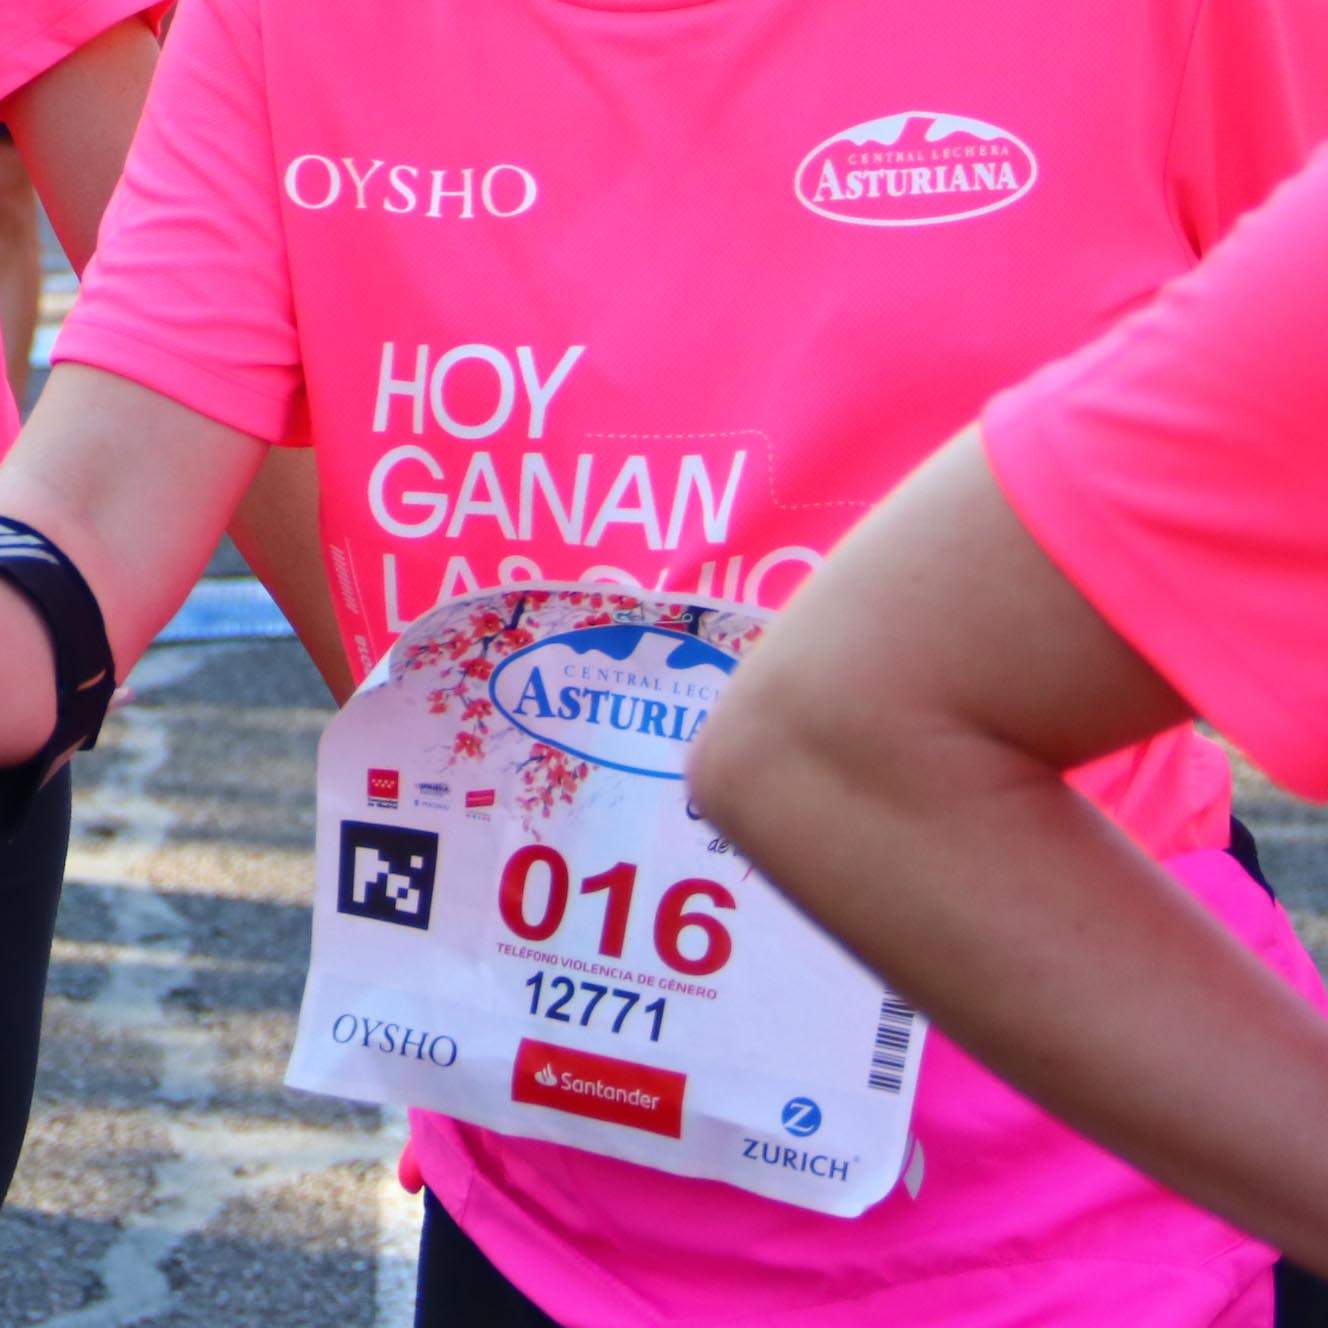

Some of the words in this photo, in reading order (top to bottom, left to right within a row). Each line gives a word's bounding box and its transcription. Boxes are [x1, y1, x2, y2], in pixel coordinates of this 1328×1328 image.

[812, 158, 1019, 203] ASTURIANA
[848, 151, 925, 165] CENTRAL
[930, 144, 1010, 160] LECHERA
[284, 154, 538, 219] OYSHO
[371, 341, 585, 441] HOY
[367, 444, 747, 552] GANAN
[512, 665, 709, 743] ASTURI
[564, 664, 663, 692] CENTRAL
[498, 843, 737, 977] 016
[496, 941, 558, 967] TELÉFONO
[560, 956, 634, 984] VIOLENCIA
[636, 972, 655, 988] DE
[658, 974, 718, 1001] GÉNERO
[525, 969, 667, 1043] 12771
[331, 1012, 459, 1069] OYSHO
[560, 1072, 660, 1110] Santander
[742, 1138, 850, 1182] ZURICH
